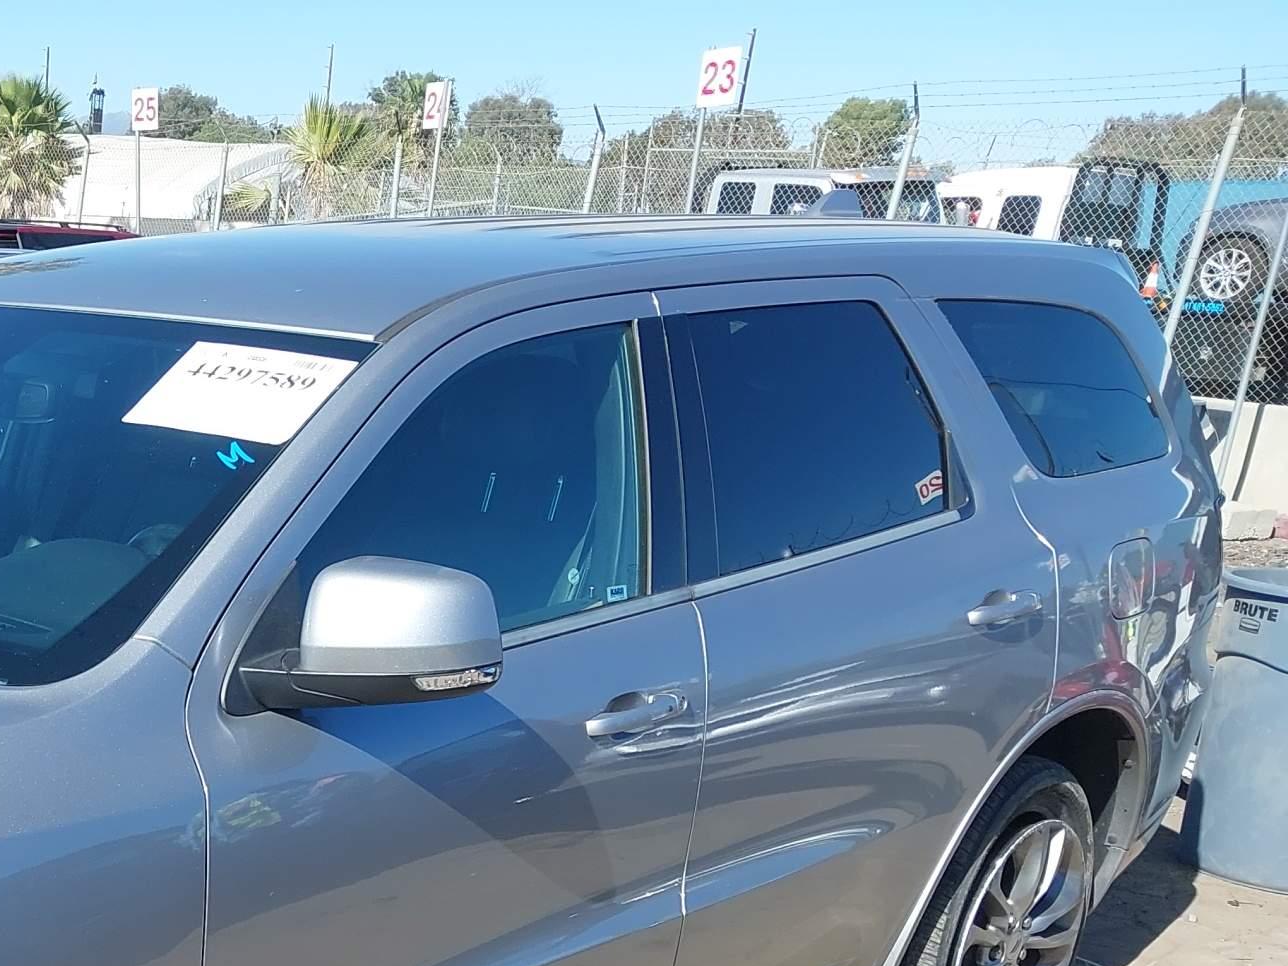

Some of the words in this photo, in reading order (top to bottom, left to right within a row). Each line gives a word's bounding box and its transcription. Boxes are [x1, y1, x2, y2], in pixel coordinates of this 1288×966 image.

[701, 59, 736, 96] 23
[134, 97, 156, 122] 25
[187, 362, 316, 391] 44297589
[216, 441, 255, 470] M
[1233, 599, 1280, 623] BRUTE
